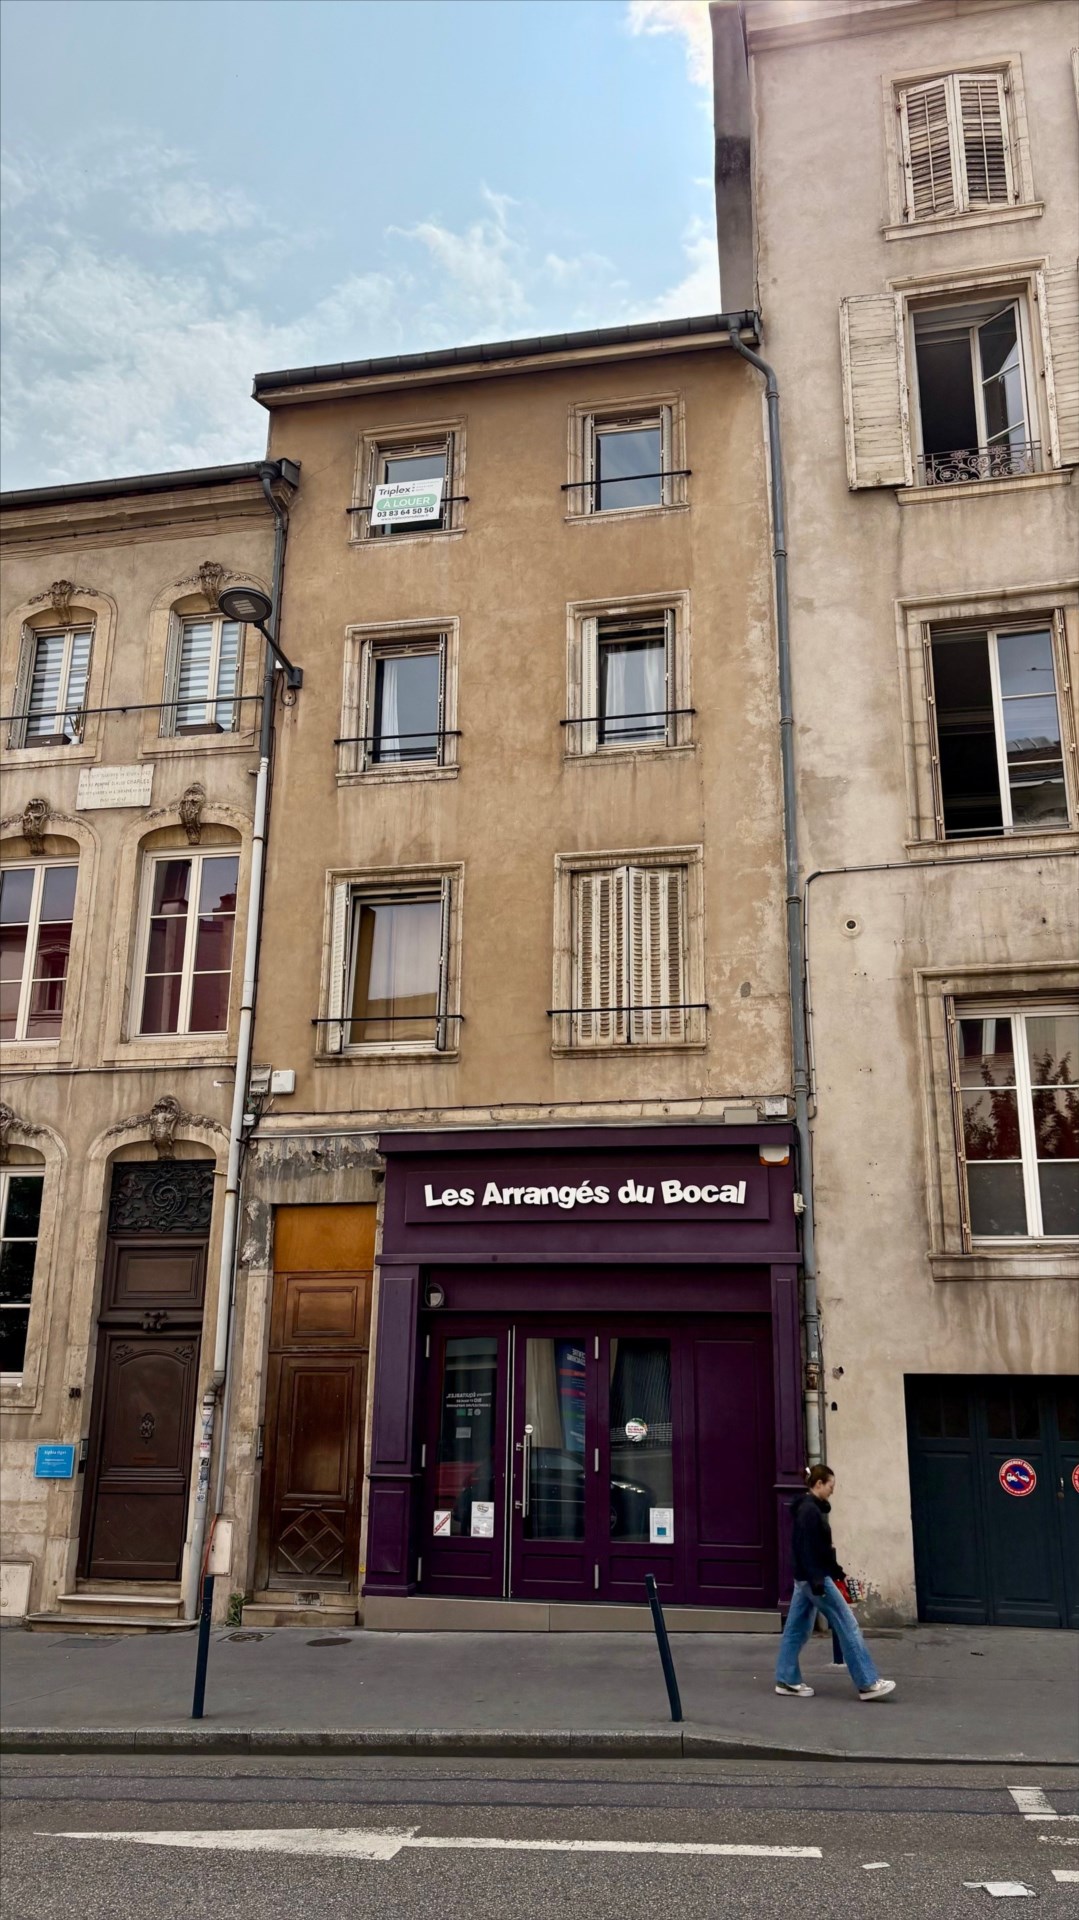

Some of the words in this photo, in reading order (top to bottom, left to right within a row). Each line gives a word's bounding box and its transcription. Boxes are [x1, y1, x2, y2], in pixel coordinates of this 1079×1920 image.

[379, 485, 411, 497] Triplex
[393, 496, 430, 507] LOUER
[424, 1184, 475, 1207] Les
[482, 1180, 610, 1209] Arrangés
[618, 1179, 655, 1204] du
[661, 1179, 747, 1205] Bocal
